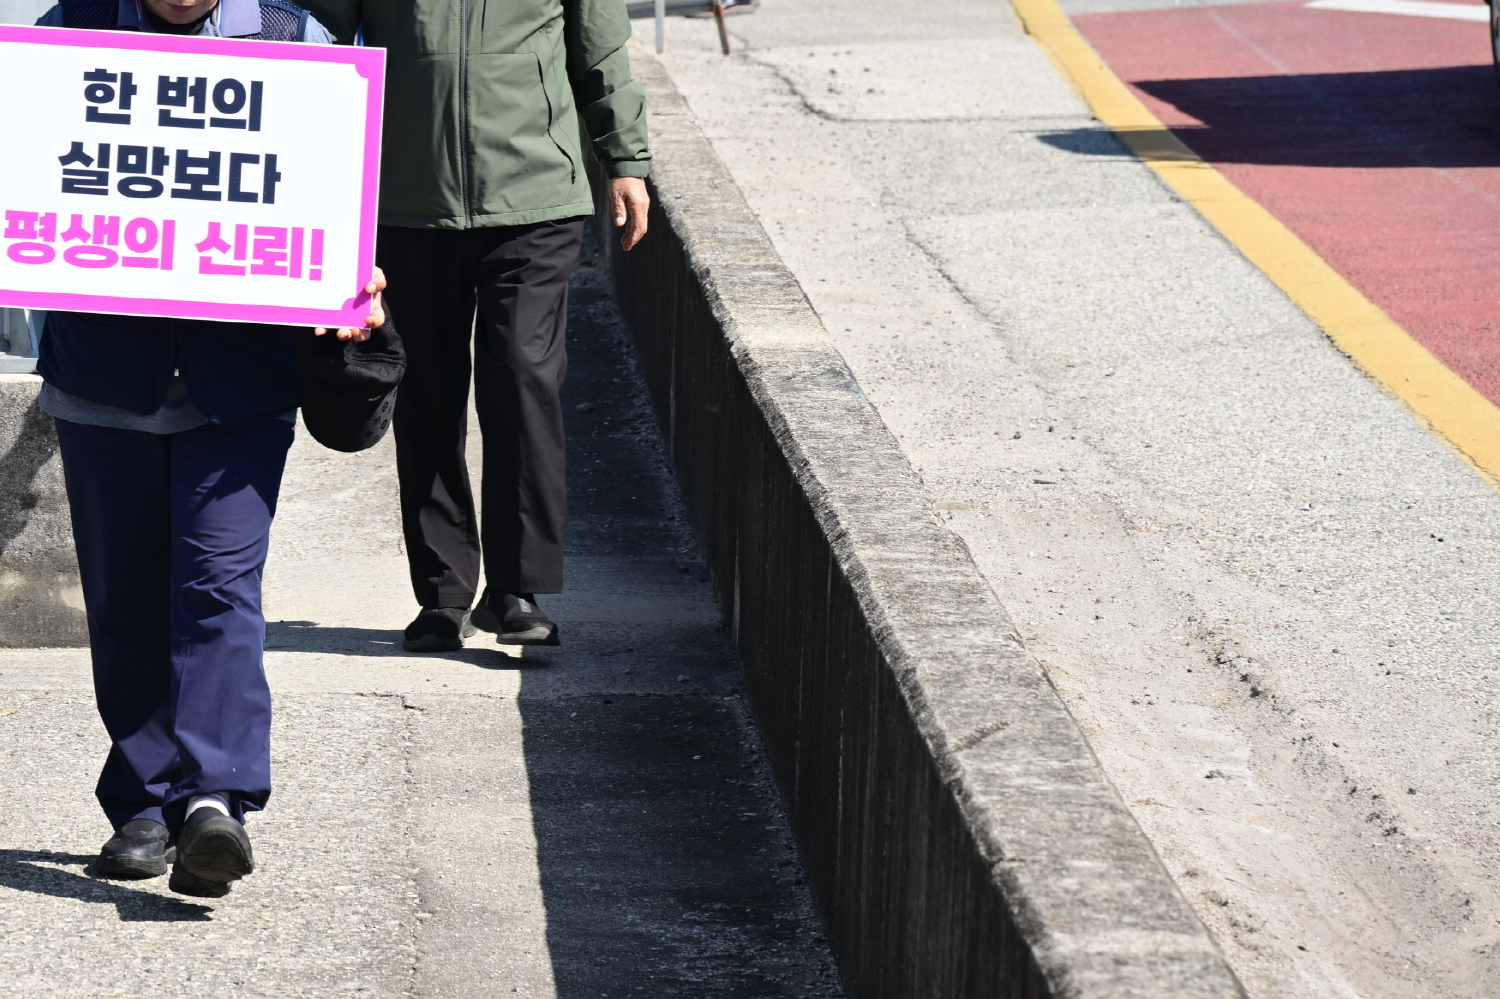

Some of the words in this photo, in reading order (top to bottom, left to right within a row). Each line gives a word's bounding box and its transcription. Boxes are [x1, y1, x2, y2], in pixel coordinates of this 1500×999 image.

[83, 67, 137, 126] 한
[156, 75, 264, 132] 번의
[57, 140, 281, 205] 실망보다
[3, 208, 176, 271] 평생의
[194, 221, 325, 282] 신뢰!
